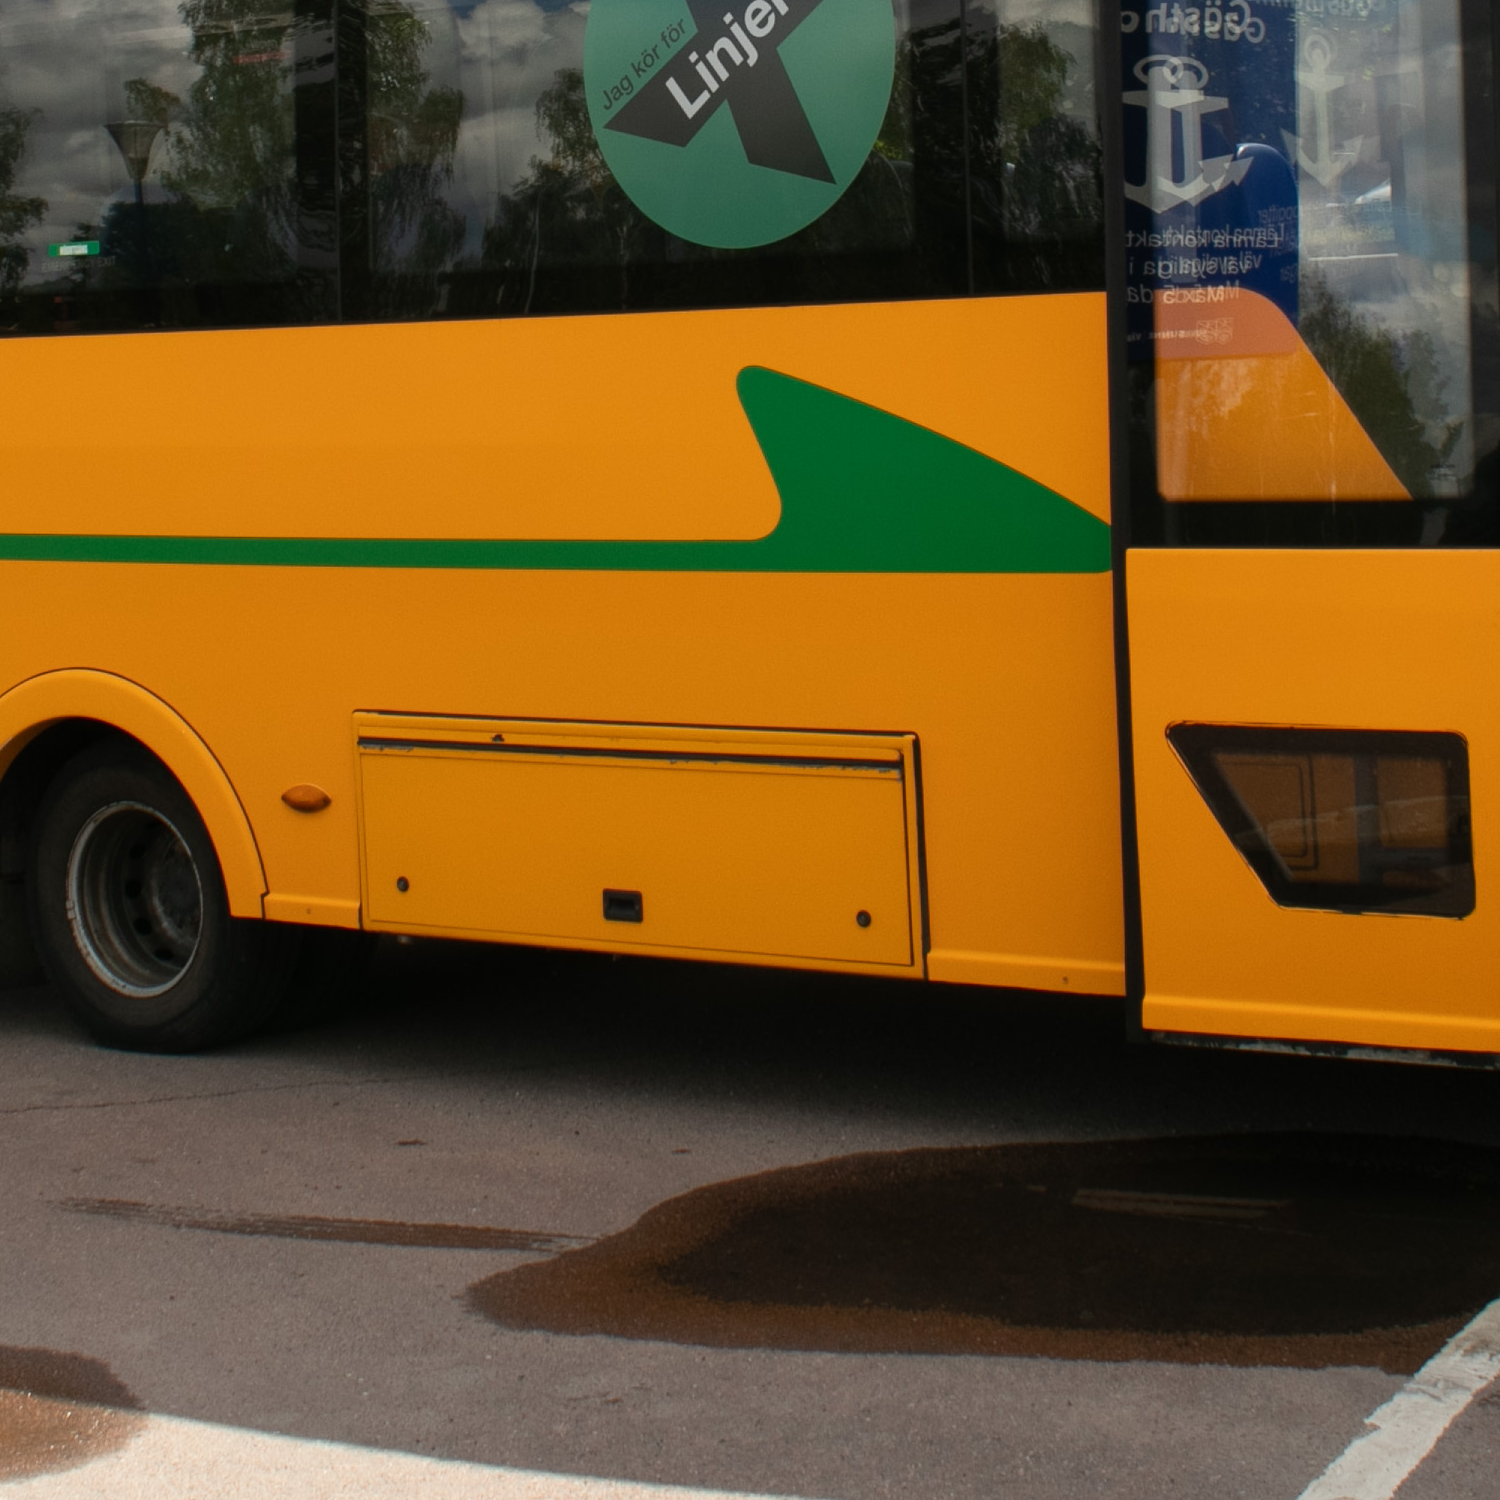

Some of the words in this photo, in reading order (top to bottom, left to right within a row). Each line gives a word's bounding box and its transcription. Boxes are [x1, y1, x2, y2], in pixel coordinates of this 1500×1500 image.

[603, 74, 634, 110] Jag
[631, 44, 660, 78] kör
[661, 18, 686, 49] för
